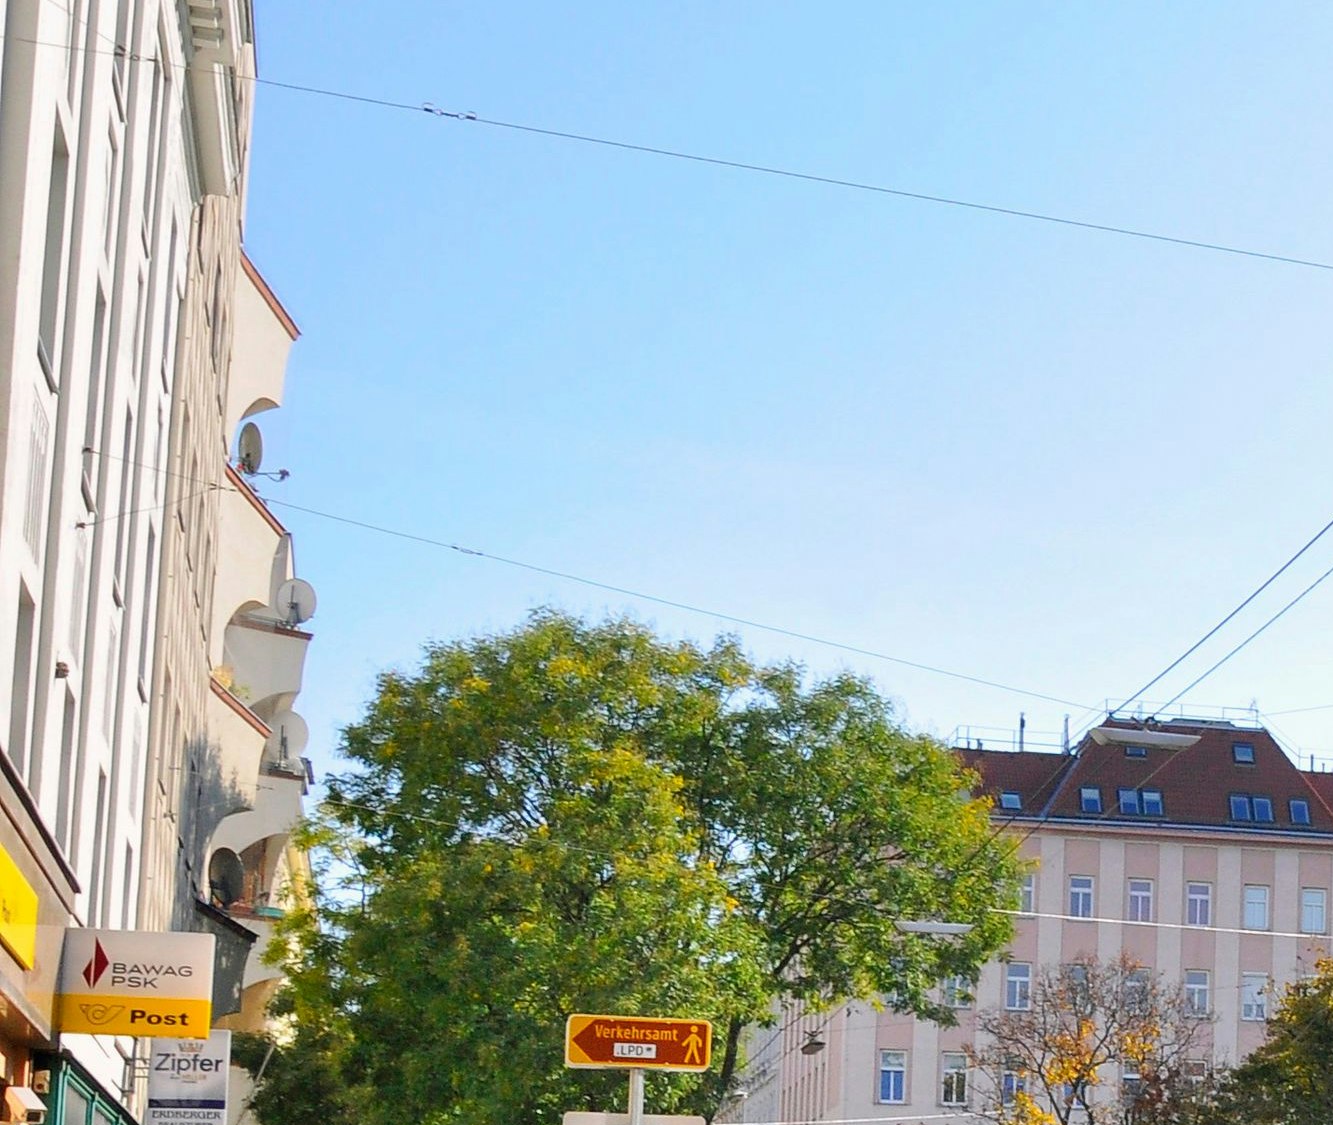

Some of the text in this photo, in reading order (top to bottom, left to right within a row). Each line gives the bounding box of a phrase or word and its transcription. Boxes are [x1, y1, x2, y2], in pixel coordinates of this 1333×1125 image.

[112, 962, 193, 977] BAWAG
[112, 976, 158, 989] PSK
[130, 1009, 189, 1026] Post
[594, 1024, 679, 1041] Verkehrsamt
[154, 1053, 223, 1075] Zipfer
[151, 1110, 221, 1120] ERDBERGER
